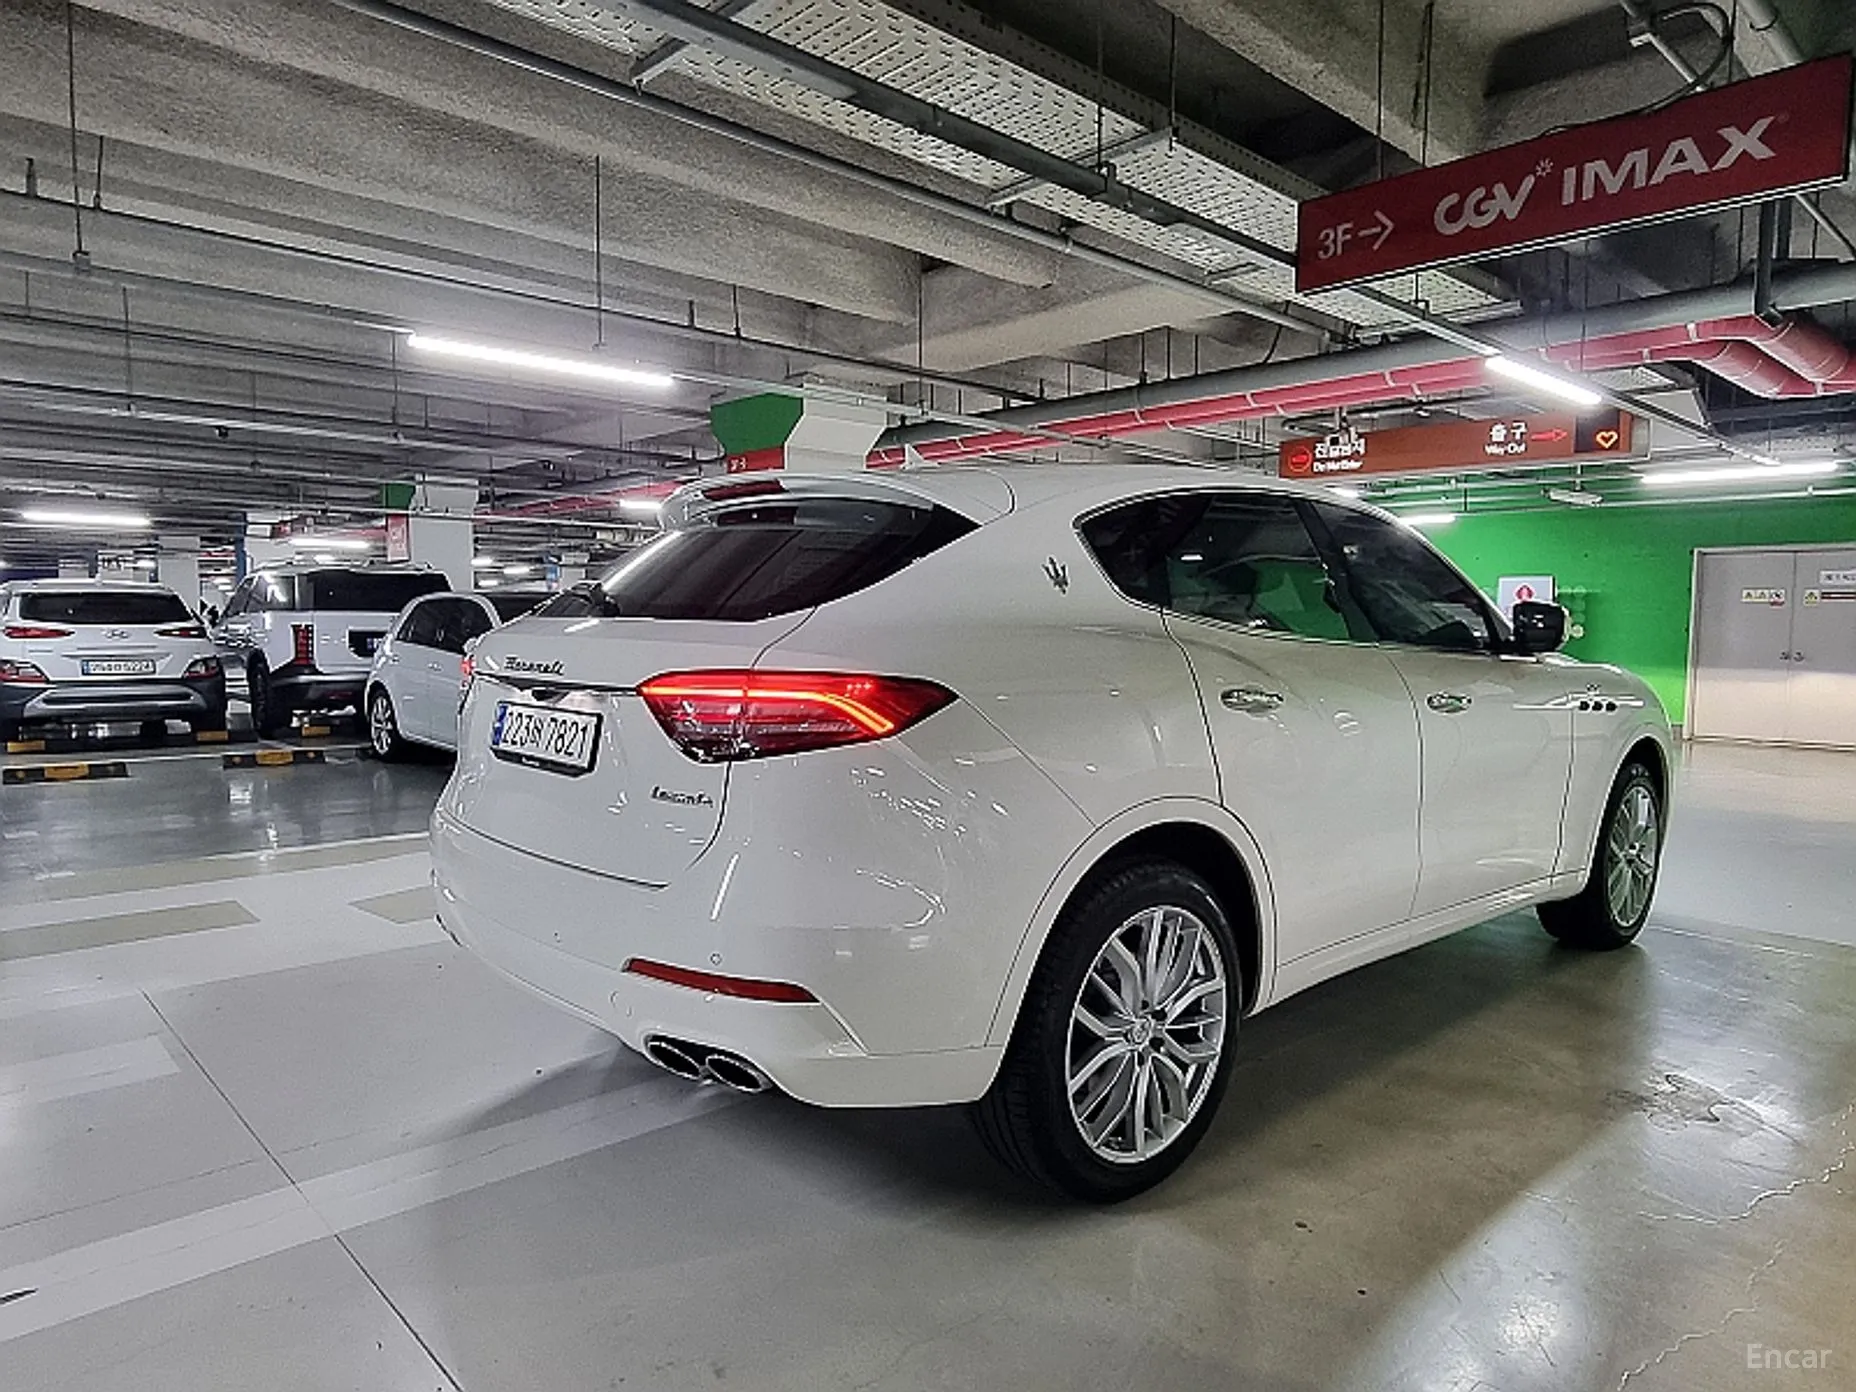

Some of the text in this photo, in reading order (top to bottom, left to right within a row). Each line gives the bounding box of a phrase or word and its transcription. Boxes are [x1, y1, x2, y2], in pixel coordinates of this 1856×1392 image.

[1317, 115, 1778, 260] 3F CGV IMAX
[545, 716, 589, 760] 7821
